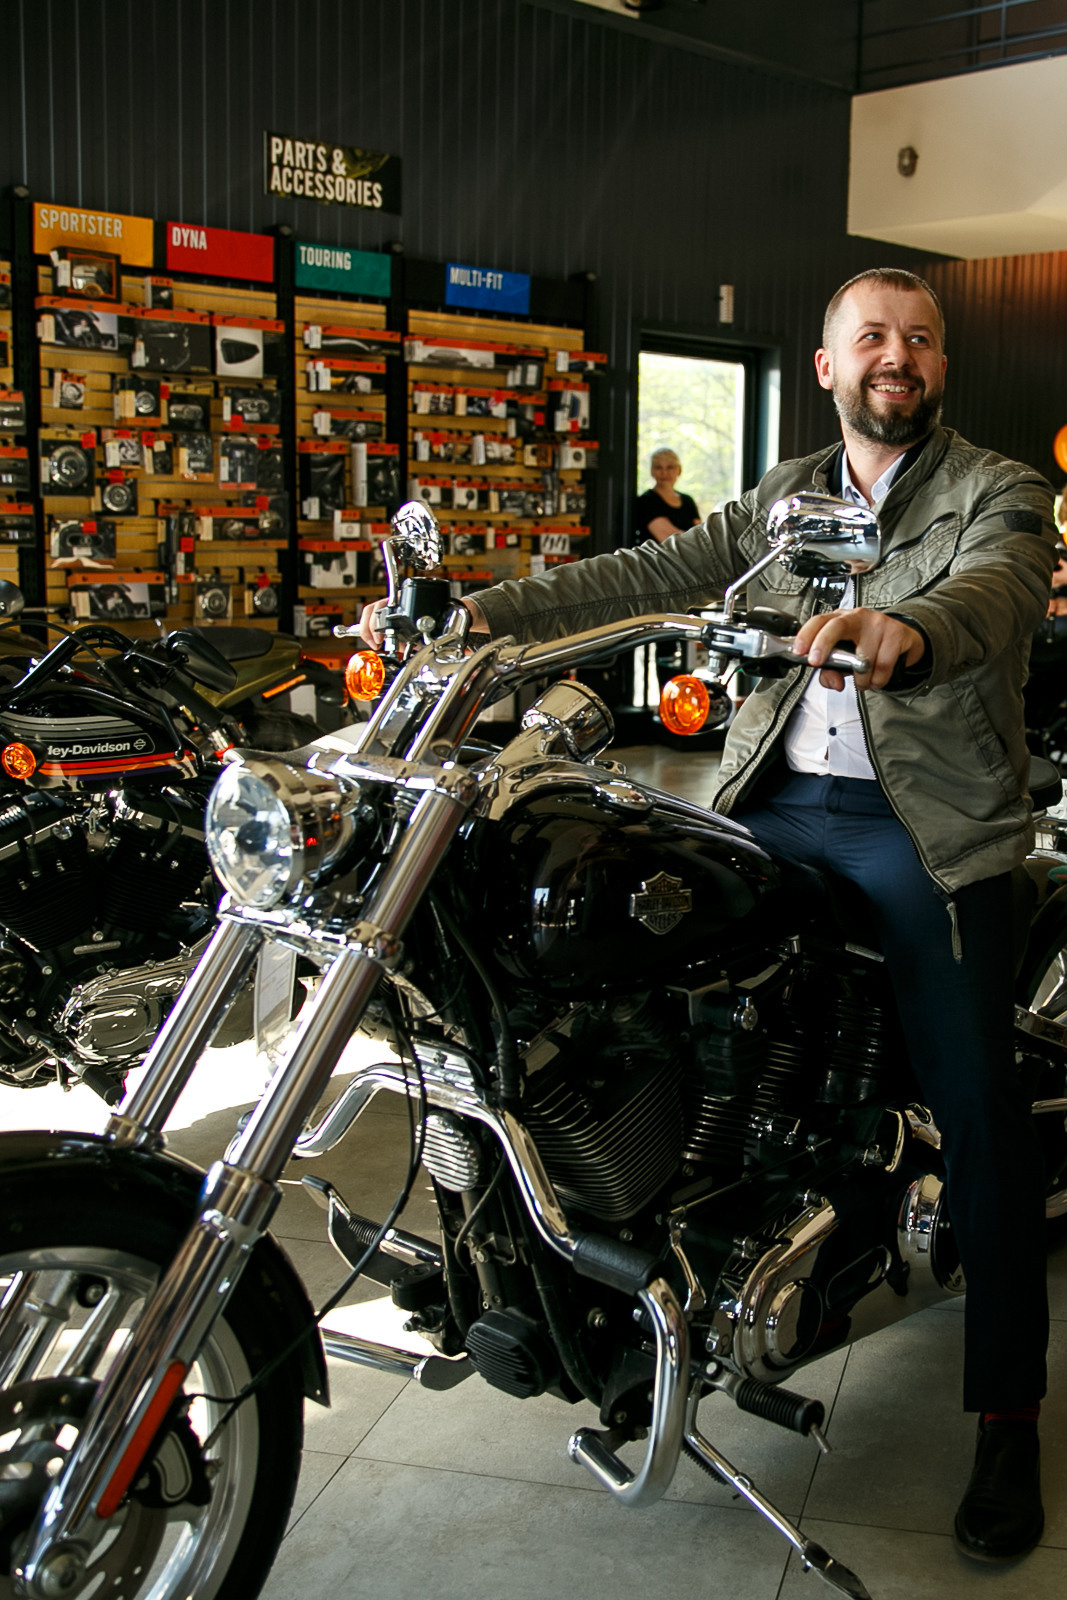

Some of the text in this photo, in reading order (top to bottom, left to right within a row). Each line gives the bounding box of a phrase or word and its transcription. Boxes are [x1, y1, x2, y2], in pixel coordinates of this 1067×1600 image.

[271, 136, 346, 176] PARTS &
[270, 165, 382, 208] ACCESSORIES
[40, 208, 122, 238] SPORTSTER
[172, 226, 207, 250] DYNA
[299, 245, 351, 270] TOURING
[450, 266, 503, 291] MULTI-FIT
[47, 742, 130, 758] ley-Davidson
